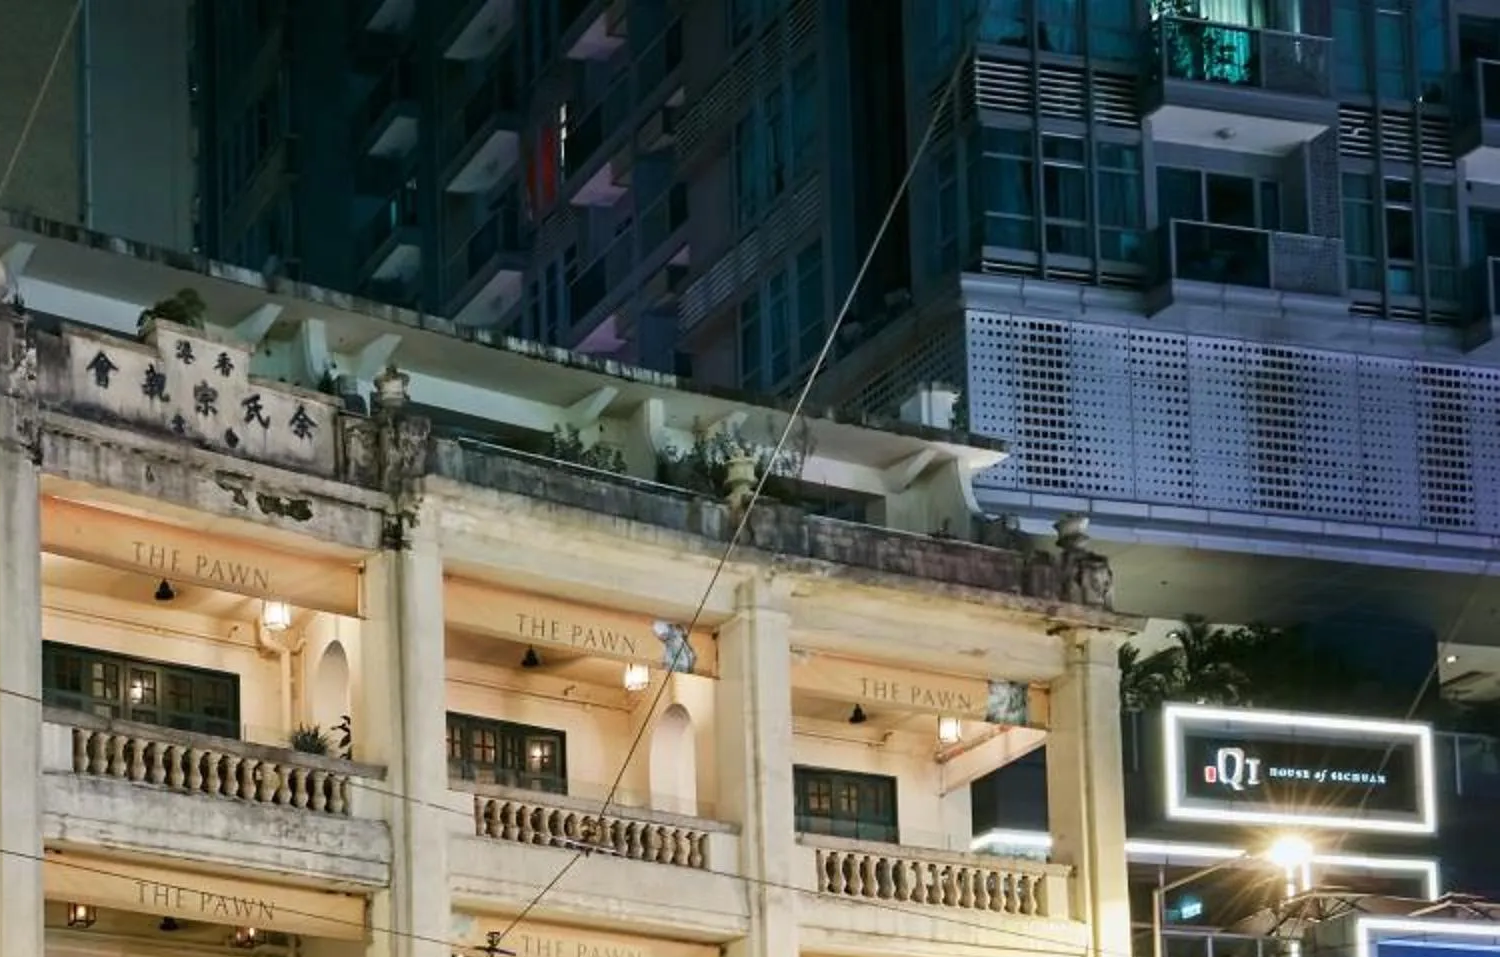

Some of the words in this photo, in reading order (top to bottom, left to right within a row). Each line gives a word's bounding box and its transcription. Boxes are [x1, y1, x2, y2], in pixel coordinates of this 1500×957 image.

[132, 541, 180, 573] THE
[195, 554, 270, 590] PAWN
[515, 613, 559, 641] THE
[570, 623, 638, 655] PAWN
[861, 677, 900, 700] THE
[910, 685, 972, 710] PAWN
[1269, 766, 1310, 779] HOUSE
[1314, 768, 1328, 783] of
[135, 880, 183, 909] THE
[200, 891, 275, 921] PAWN
